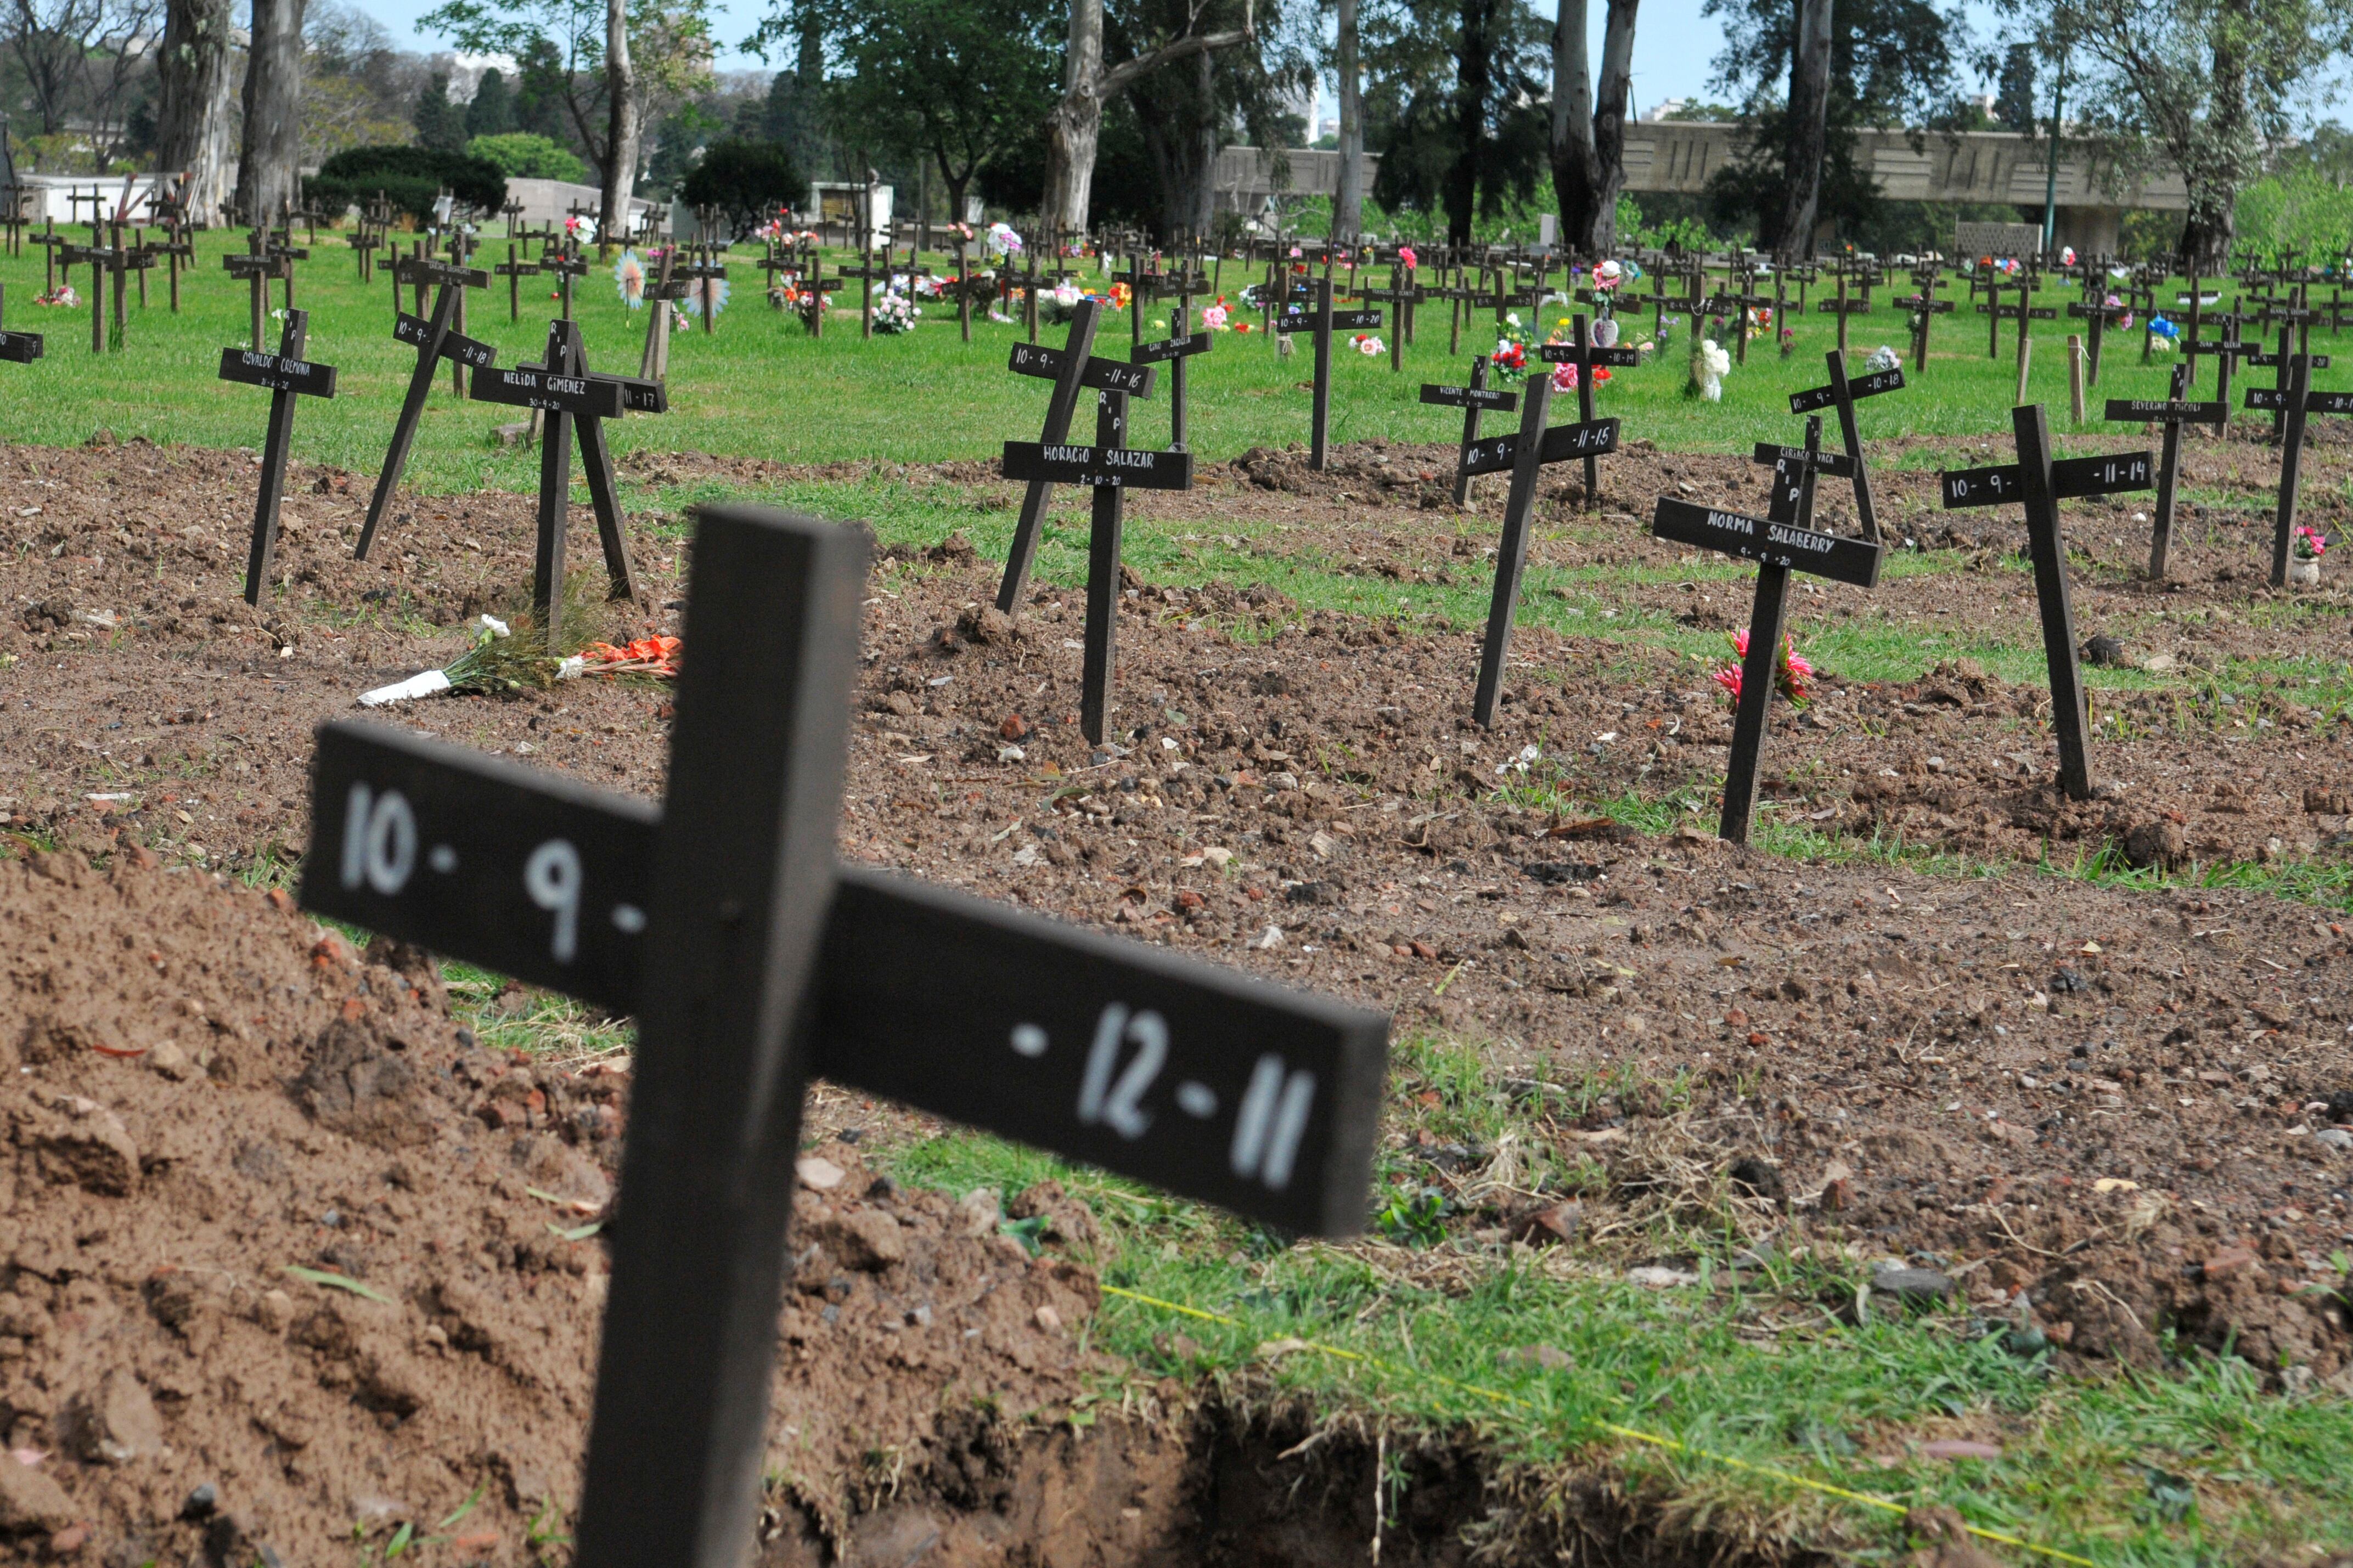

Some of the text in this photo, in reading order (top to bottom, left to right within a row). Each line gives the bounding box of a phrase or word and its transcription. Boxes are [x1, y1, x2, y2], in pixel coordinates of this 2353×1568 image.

[243, 351, 310, 376] OSVALDO CREMONA
[1106, 449, 1155, 470] SALAZAR
[1817, 453, 1834, 465] VACA
[1708, 510, 1836, 554] NORMA SALABERRY
